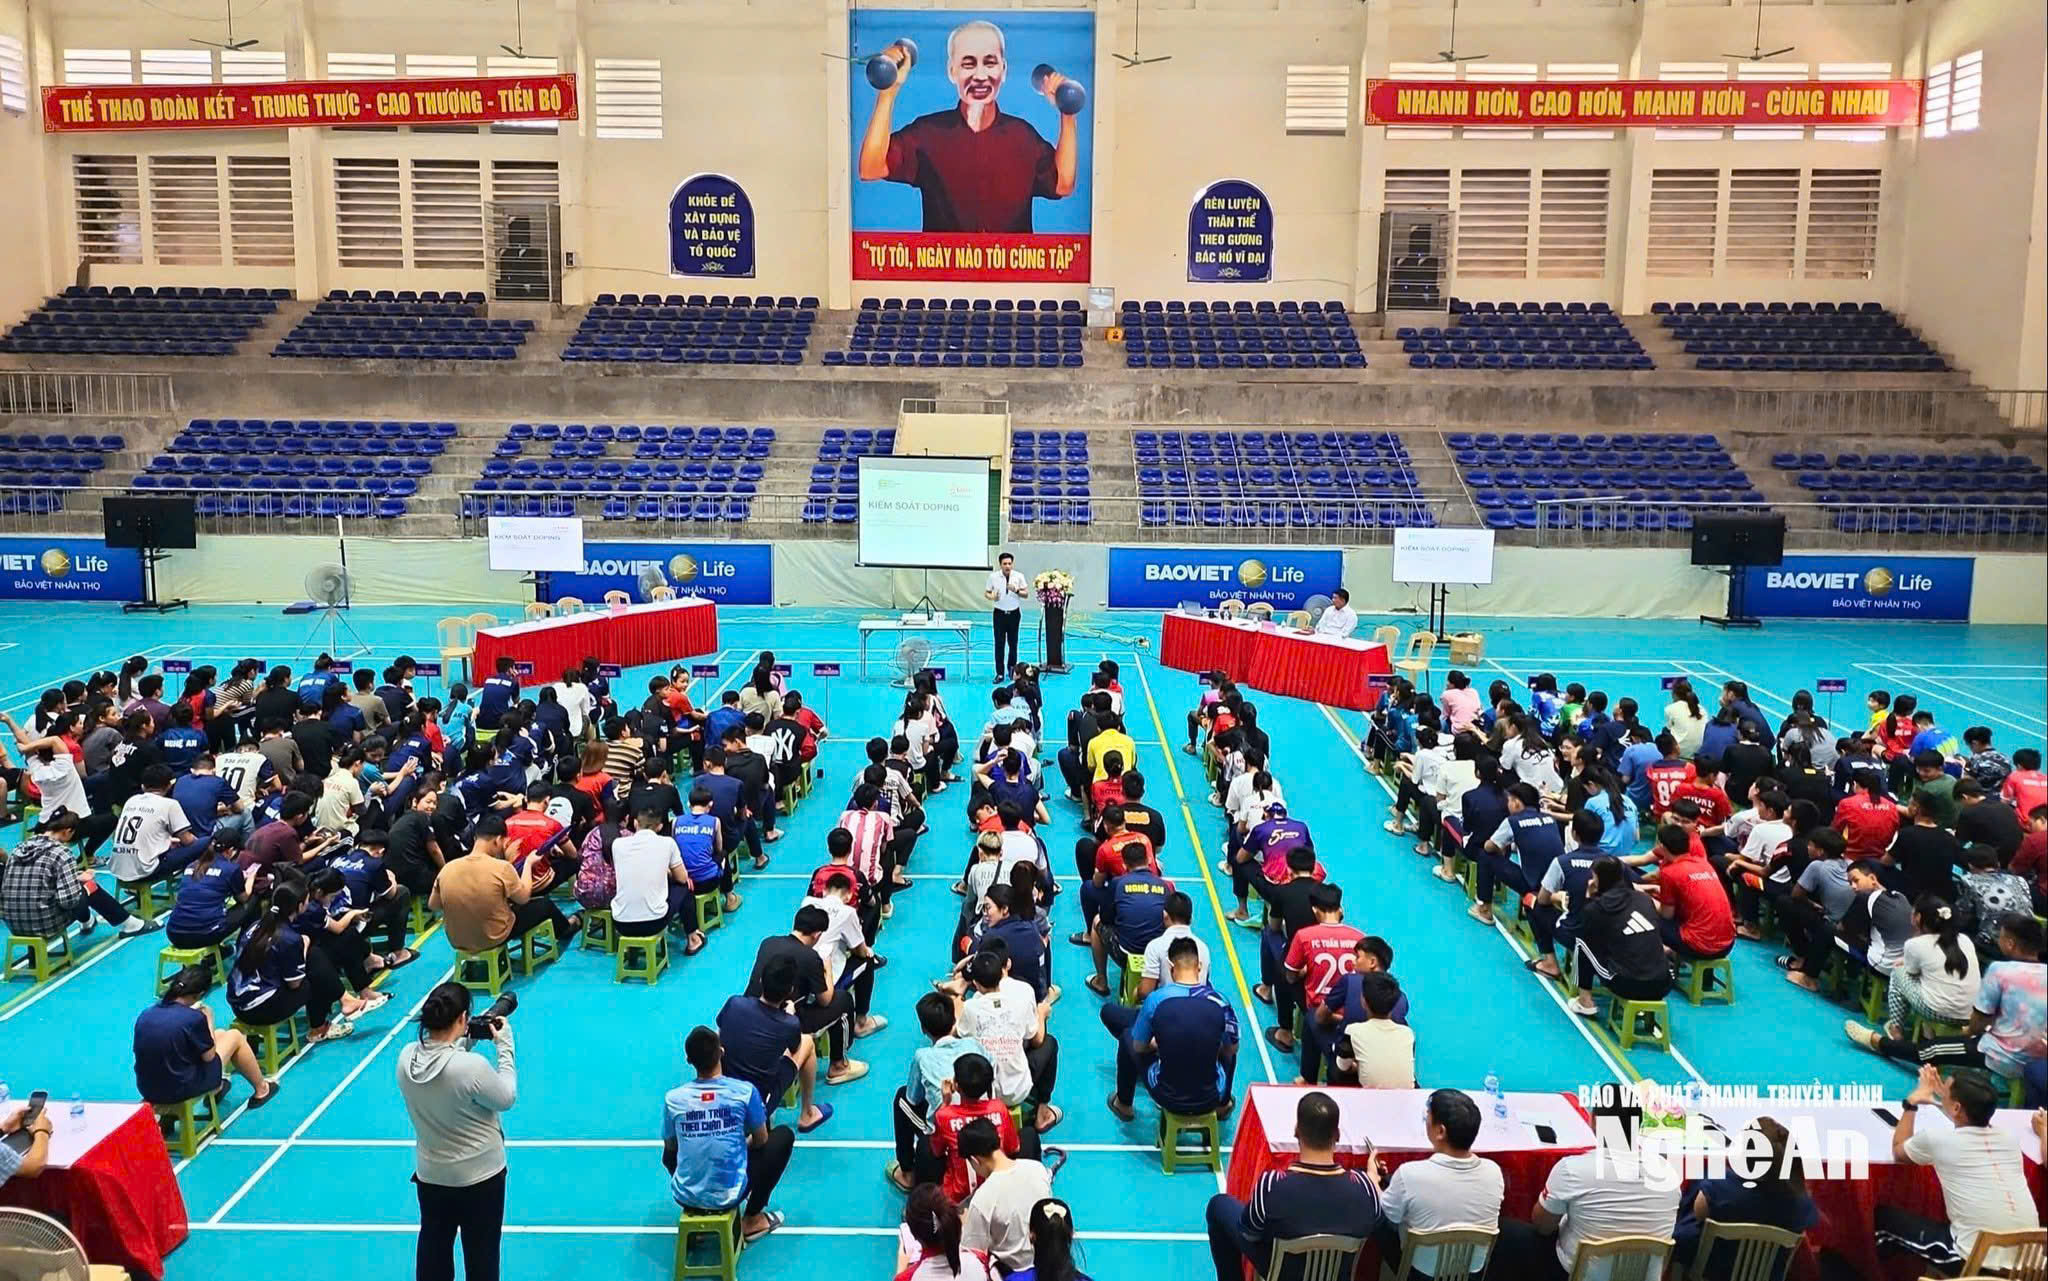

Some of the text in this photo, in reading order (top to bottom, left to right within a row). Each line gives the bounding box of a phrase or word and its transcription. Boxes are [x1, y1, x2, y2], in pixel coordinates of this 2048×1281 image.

[60, 91, 94, 122] THỂ
[98, 98, 145, 122] THAO
[151, 94, 199, 121] ĐOÀN
[204, 89, 235, 119] KẾT
[252, 94, 309, 118] TRUNG
[314, 89, 360, 120] THỰC
[377, 92, 410, 116] CAO
[415, 88, 483, 118] THƯỢNG
[498, 82, 534, 112] TIẾN
[539, 84, 562, 116] BỘ
[1397, 90, 1469, 115] NHANH
[1475, 88, 1523, 118] HƠN,
[1530, 91, 1572, 116] CAO
[1578, 88, 1626, 118] HƠN,
[1633, 90, 1694, 120] MẠNH
[1701, 87, 1745, 115] HƠN
[1766, 87, 1825, 115] CÙNG
[1832, 90, 1889, 115] NHAU
[688, 193, 736, 207] KHỎE ĐỂ
[1204, 196, 1260, 212] RÈN LUYỆN
[684, 211, 740, 226] XÂY DỰNG
[1208, 212, 1257, 228] THÂN THỂ
[684, 226, 741, 243] VÀ BẢO VỆ
[1200, 233, 1263, 246] THEO GƯƠNG
[689, 243, 736, 258] TỔ QUỐC
[889, 242, 913, 271] TÔI,
[917, 243, 951, 269] NGÀY
[955, 243, 982, 269] NÀO
[986, 244, 1006, 269] TÔI
[1010, 244, 1046, 270] CŨNG
[1195, 249, 1216, 263] BÁC
[1247, 252, 1265, 266] ĐẠI
[895, 501, 920, 511] SOÁT
[923, 503, 960, 512] DOPING
[0, 554, 108, 573] IET Life
[703, 560, 736, 577] Life
[1145, 565, 1305, 583] BAOVIET Life
[1767, 572, 1933, 591] BAOVIET Life
[14, 578, 101, 592] BẢO VIỆT NHÂN THỌ
[681, 585, 706, 594] NHÂN
[708, 586, 727, 596] THỌ
[1209, 591, 1295, 602] BẢO VIỆT NHÂN THỌ
[1833, 598, 1852, 607] BẢO
[1853, 599, 1873, 608] VIỆT
[1874, 600, 1900, 608] NHÂN
[116, 816, 144, 844] 18
[680, 1121, 700, 1132] THEO
[950, 1118, 964, 1132] FC
